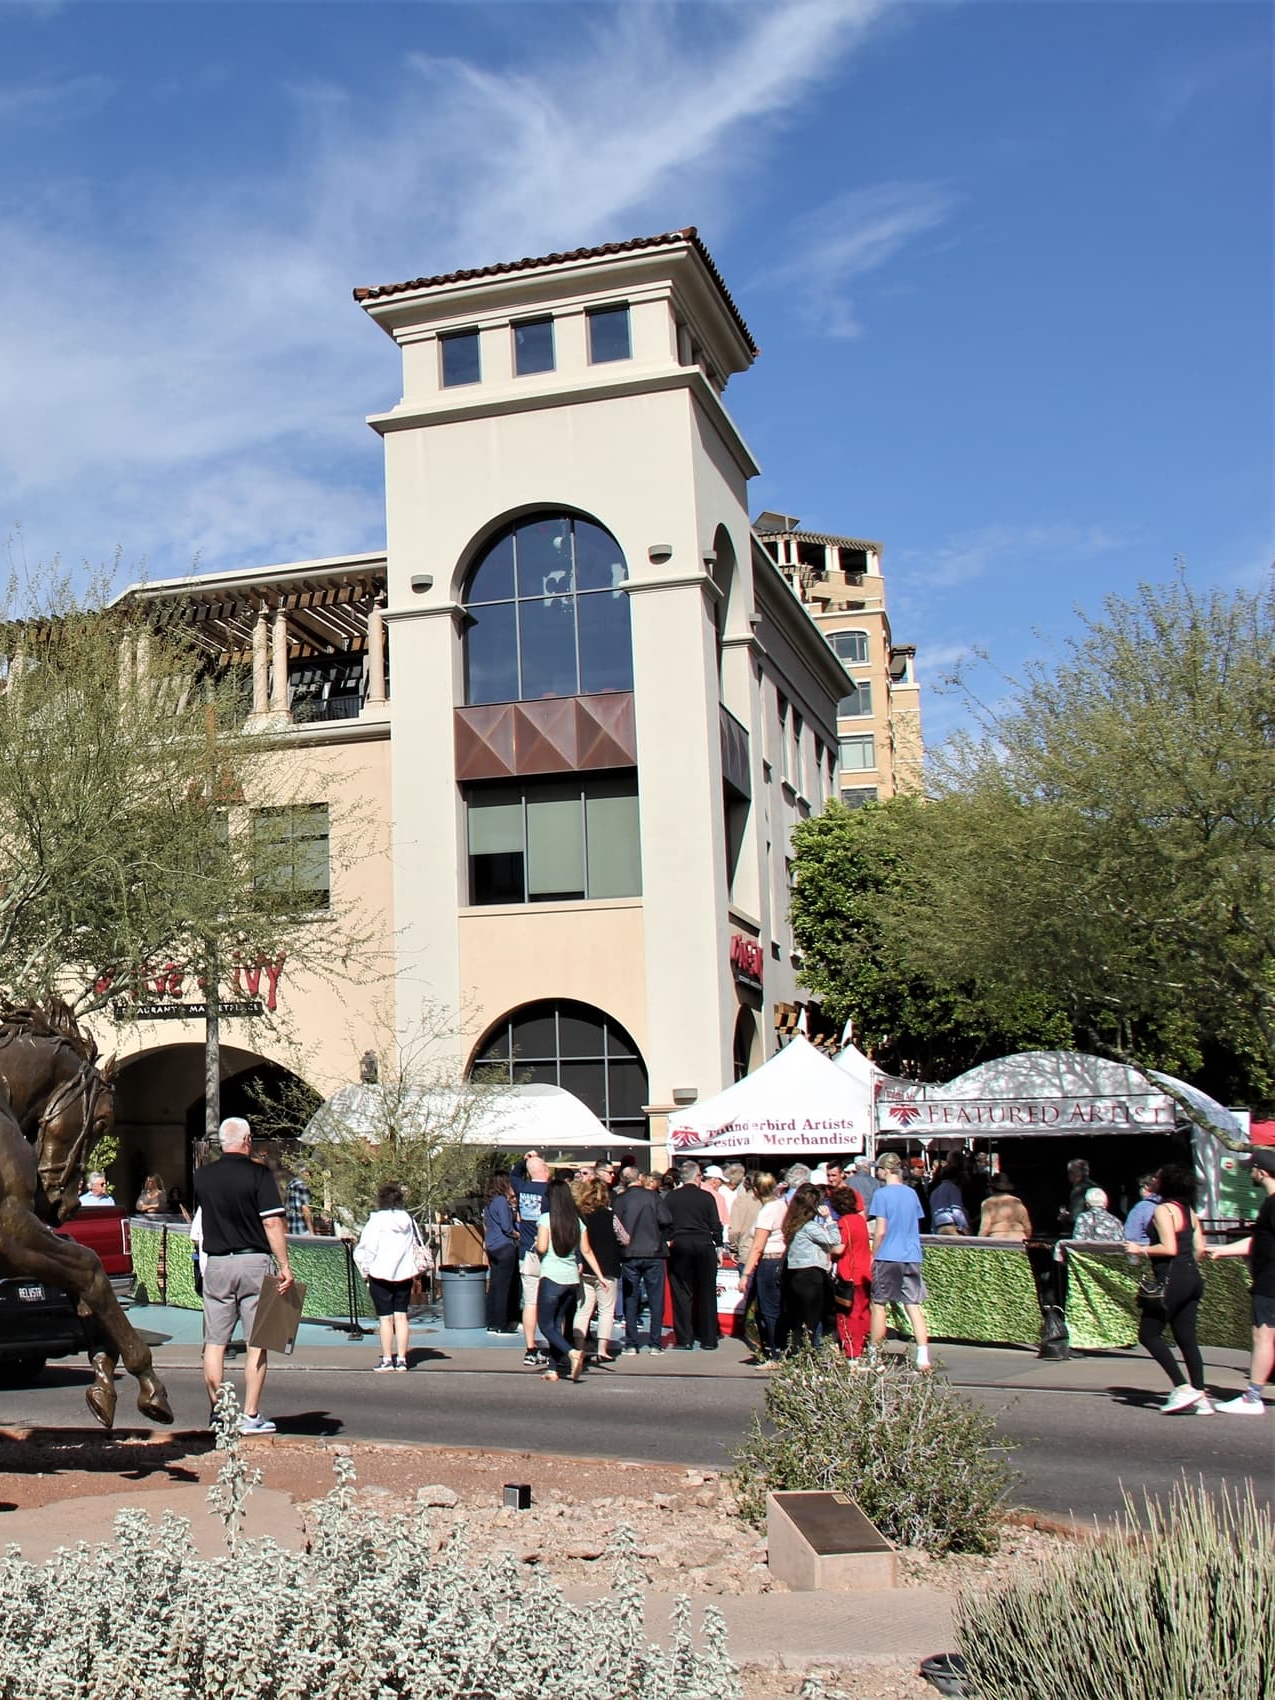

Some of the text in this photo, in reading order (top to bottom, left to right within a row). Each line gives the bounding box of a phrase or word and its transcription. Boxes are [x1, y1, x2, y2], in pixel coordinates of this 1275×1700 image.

[928, 1102, 1166, 1124] FEATURED ARTIST
[802, 1117, 854, 1131] Artists
[763, 1133, 858, 1146] Merchandise
